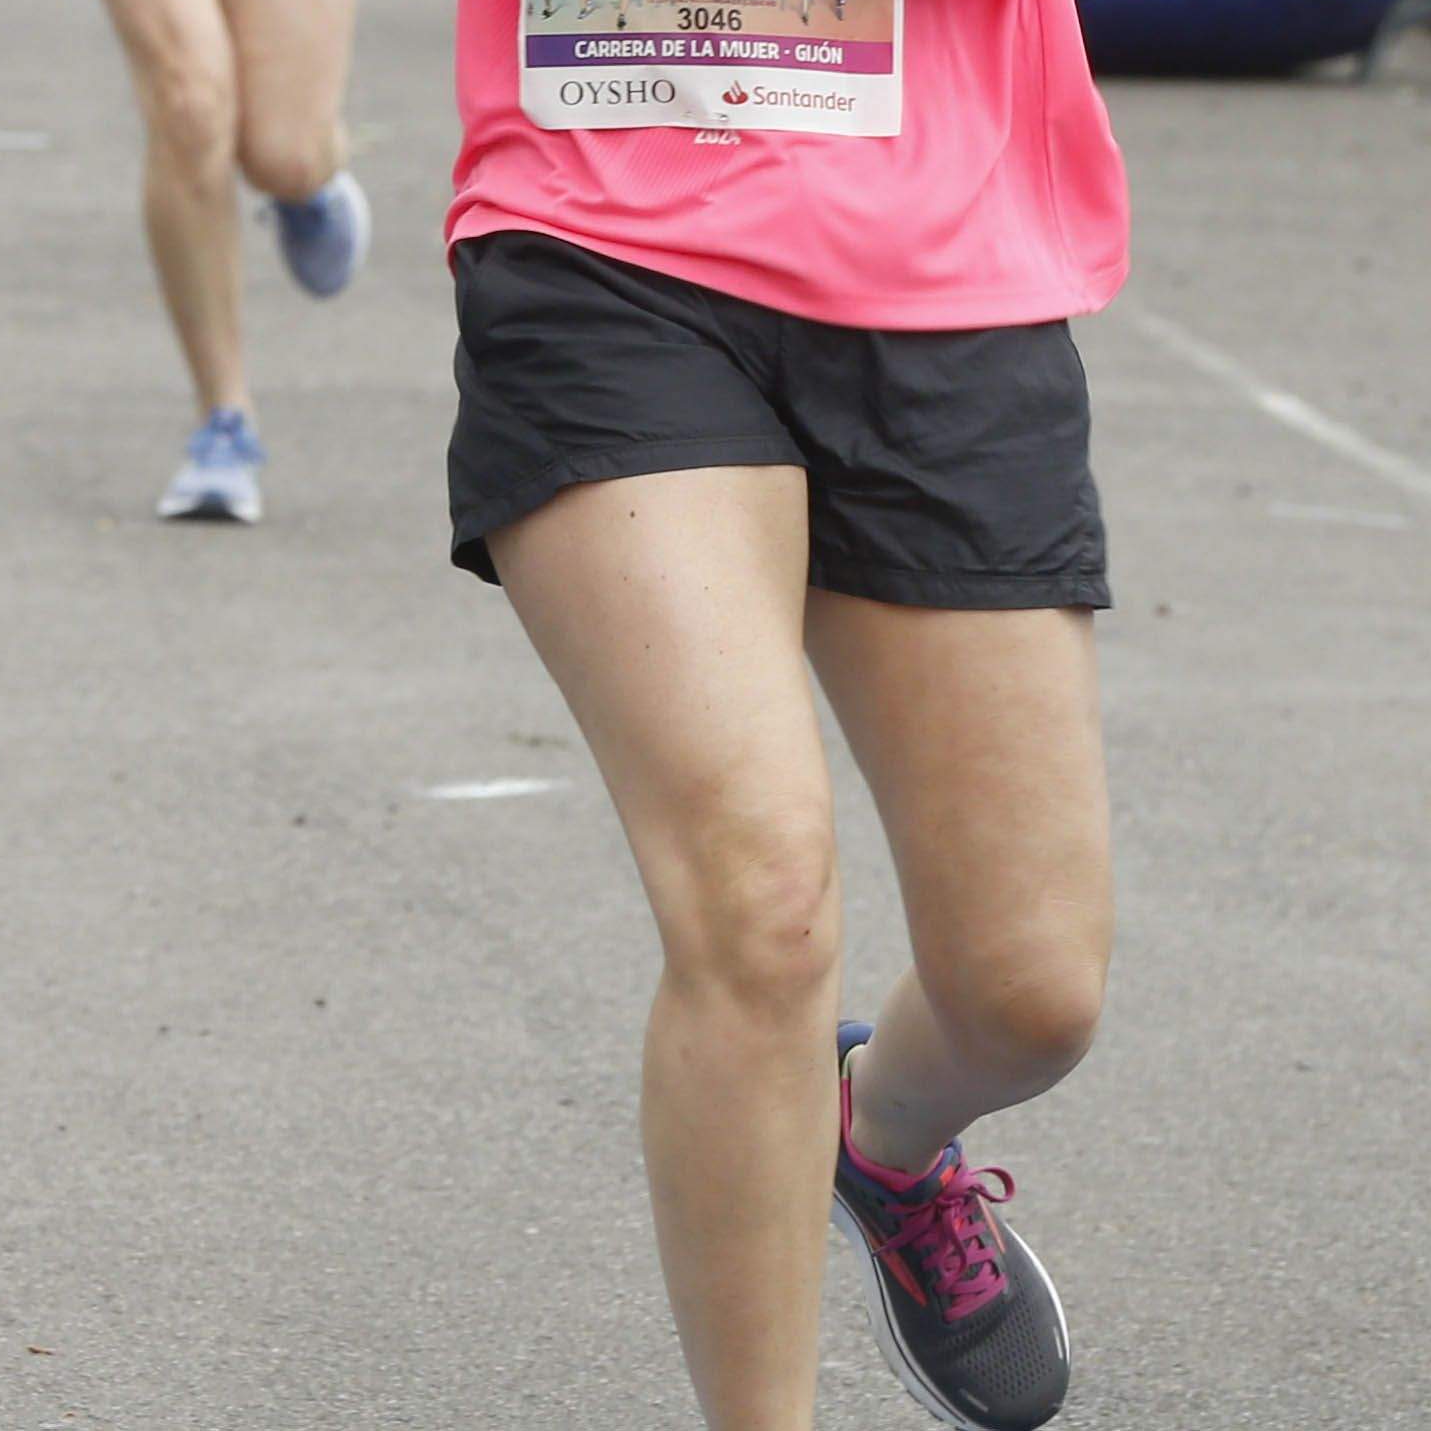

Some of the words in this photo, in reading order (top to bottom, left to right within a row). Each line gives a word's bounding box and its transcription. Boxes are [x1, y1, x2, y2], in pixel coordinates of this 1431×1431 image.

[677, 7, 742, 31] 3046
[574, 39, 656, 58] CARRERA
[661, 40, 686, 57] DE
[691, 40, 714, 57] LA
[719, 42, 780, 60] MUJER
[795, 42, 843, 64] GIJÓN
[560, 79, 675, 105] OYSHO
[753, 86, 856, 112] Santander
